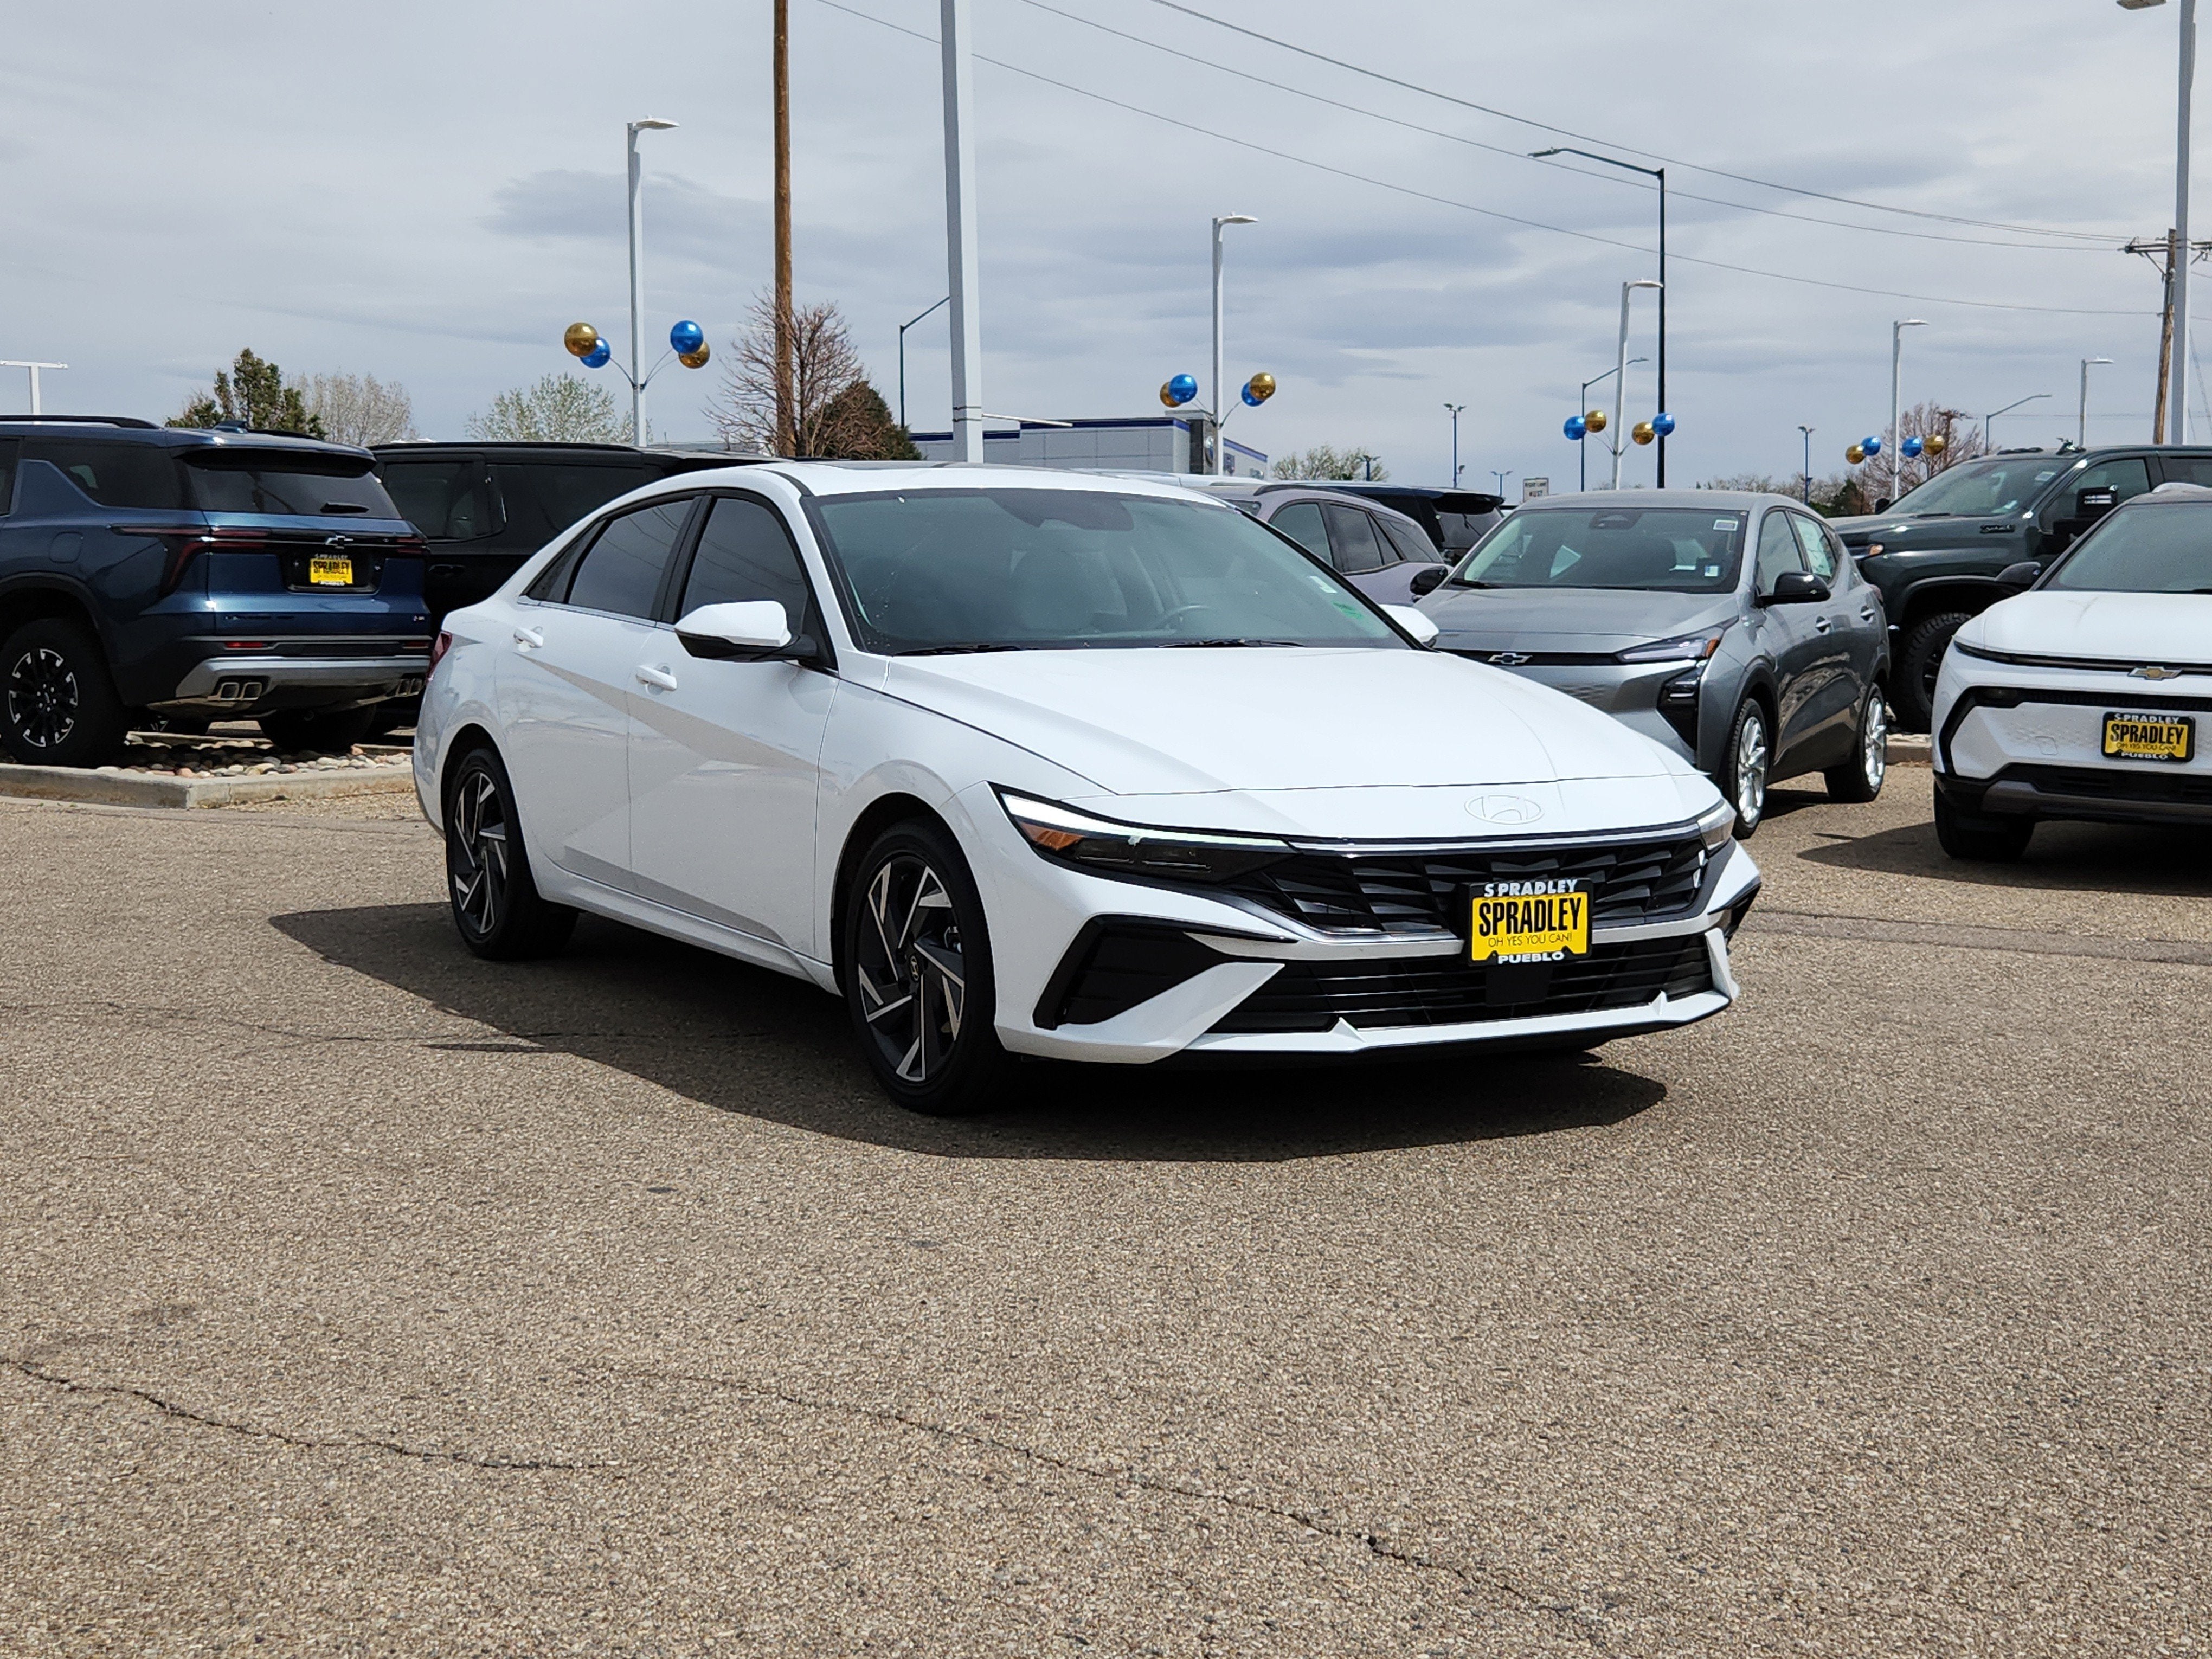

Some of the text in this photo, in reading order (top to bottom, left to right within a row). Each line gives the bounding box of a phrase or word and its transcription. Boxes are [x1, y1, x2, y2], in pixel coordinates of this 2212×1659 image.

[2114, 713, 2179, 724] SPRADLEY
[2110, 723, 2184, 745] SPRADLEY
[2121, 751, 2168, 760] PUEBLO
[1484, 879, 1577, 898] SPRADLEY
[1479, 897, 1581, 937] SPRADLEY
[1488, 932, 1572, 948] OH YES YOU CAN!
[1497, 951, 1565, 964] PUEBLO
